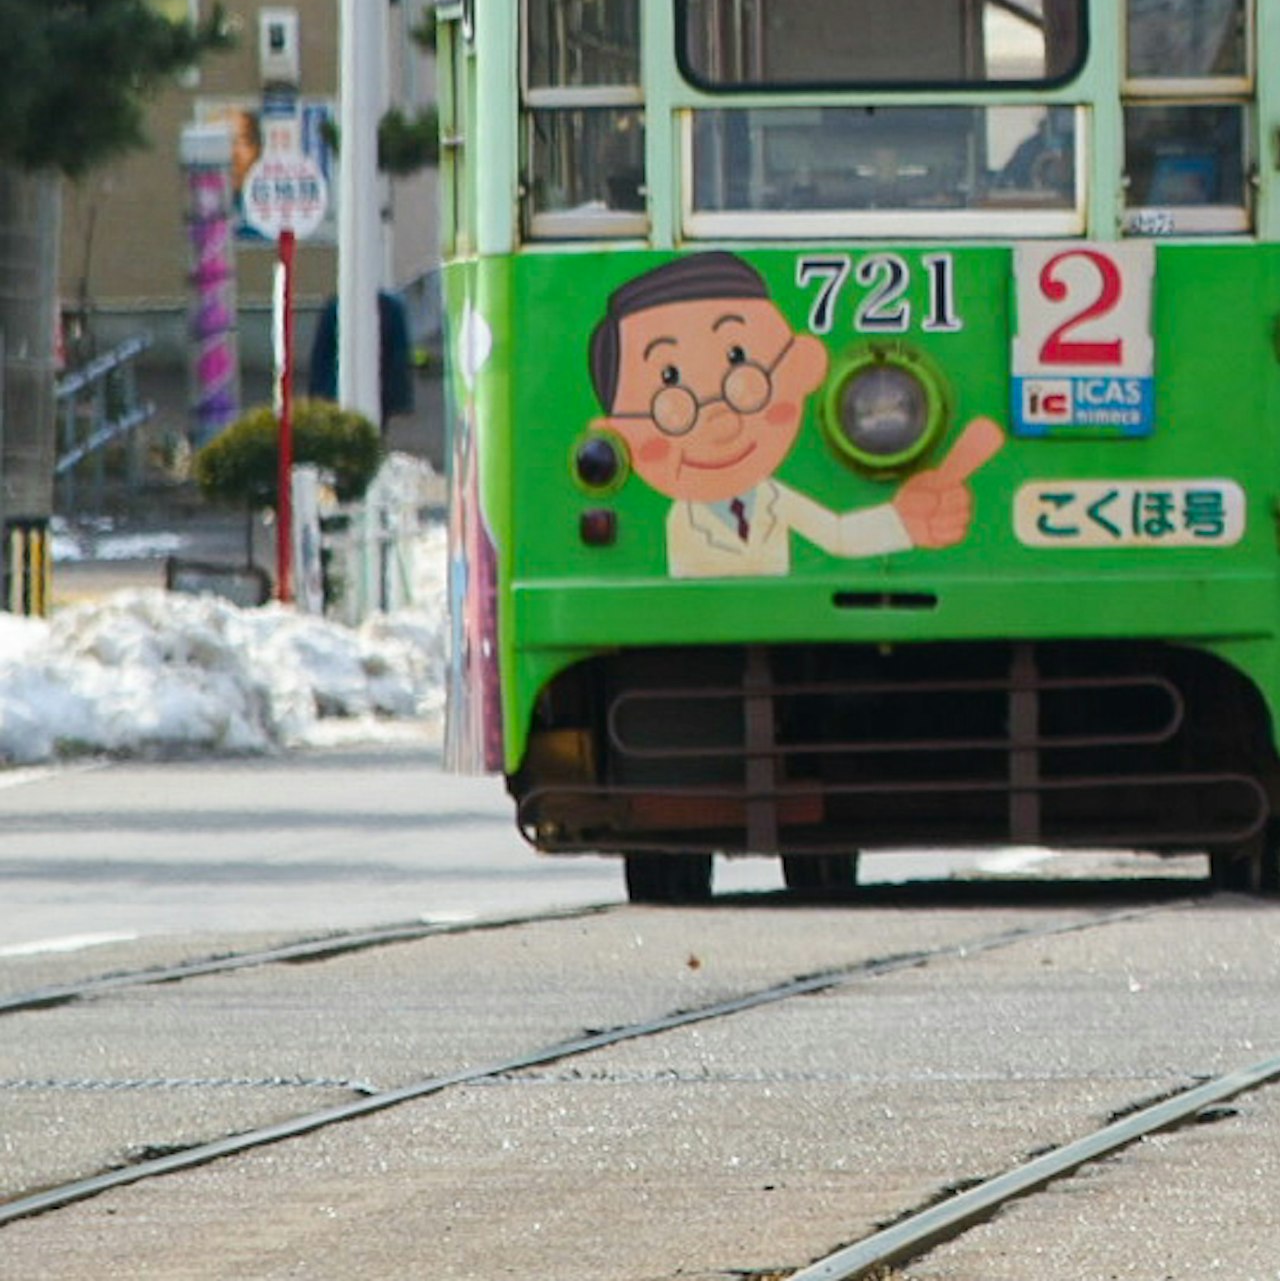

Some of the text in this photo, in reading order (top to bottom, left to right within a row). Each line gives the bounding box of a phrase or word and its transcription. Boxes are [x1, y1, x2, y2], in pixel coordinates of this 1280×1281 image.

[798, 253, 962, 333] 721
[1038, 249, 1123, 366] 2
[1075, 380, 1142, 405] ICAS
[1036, 488, 1226, 538] こくほ号
